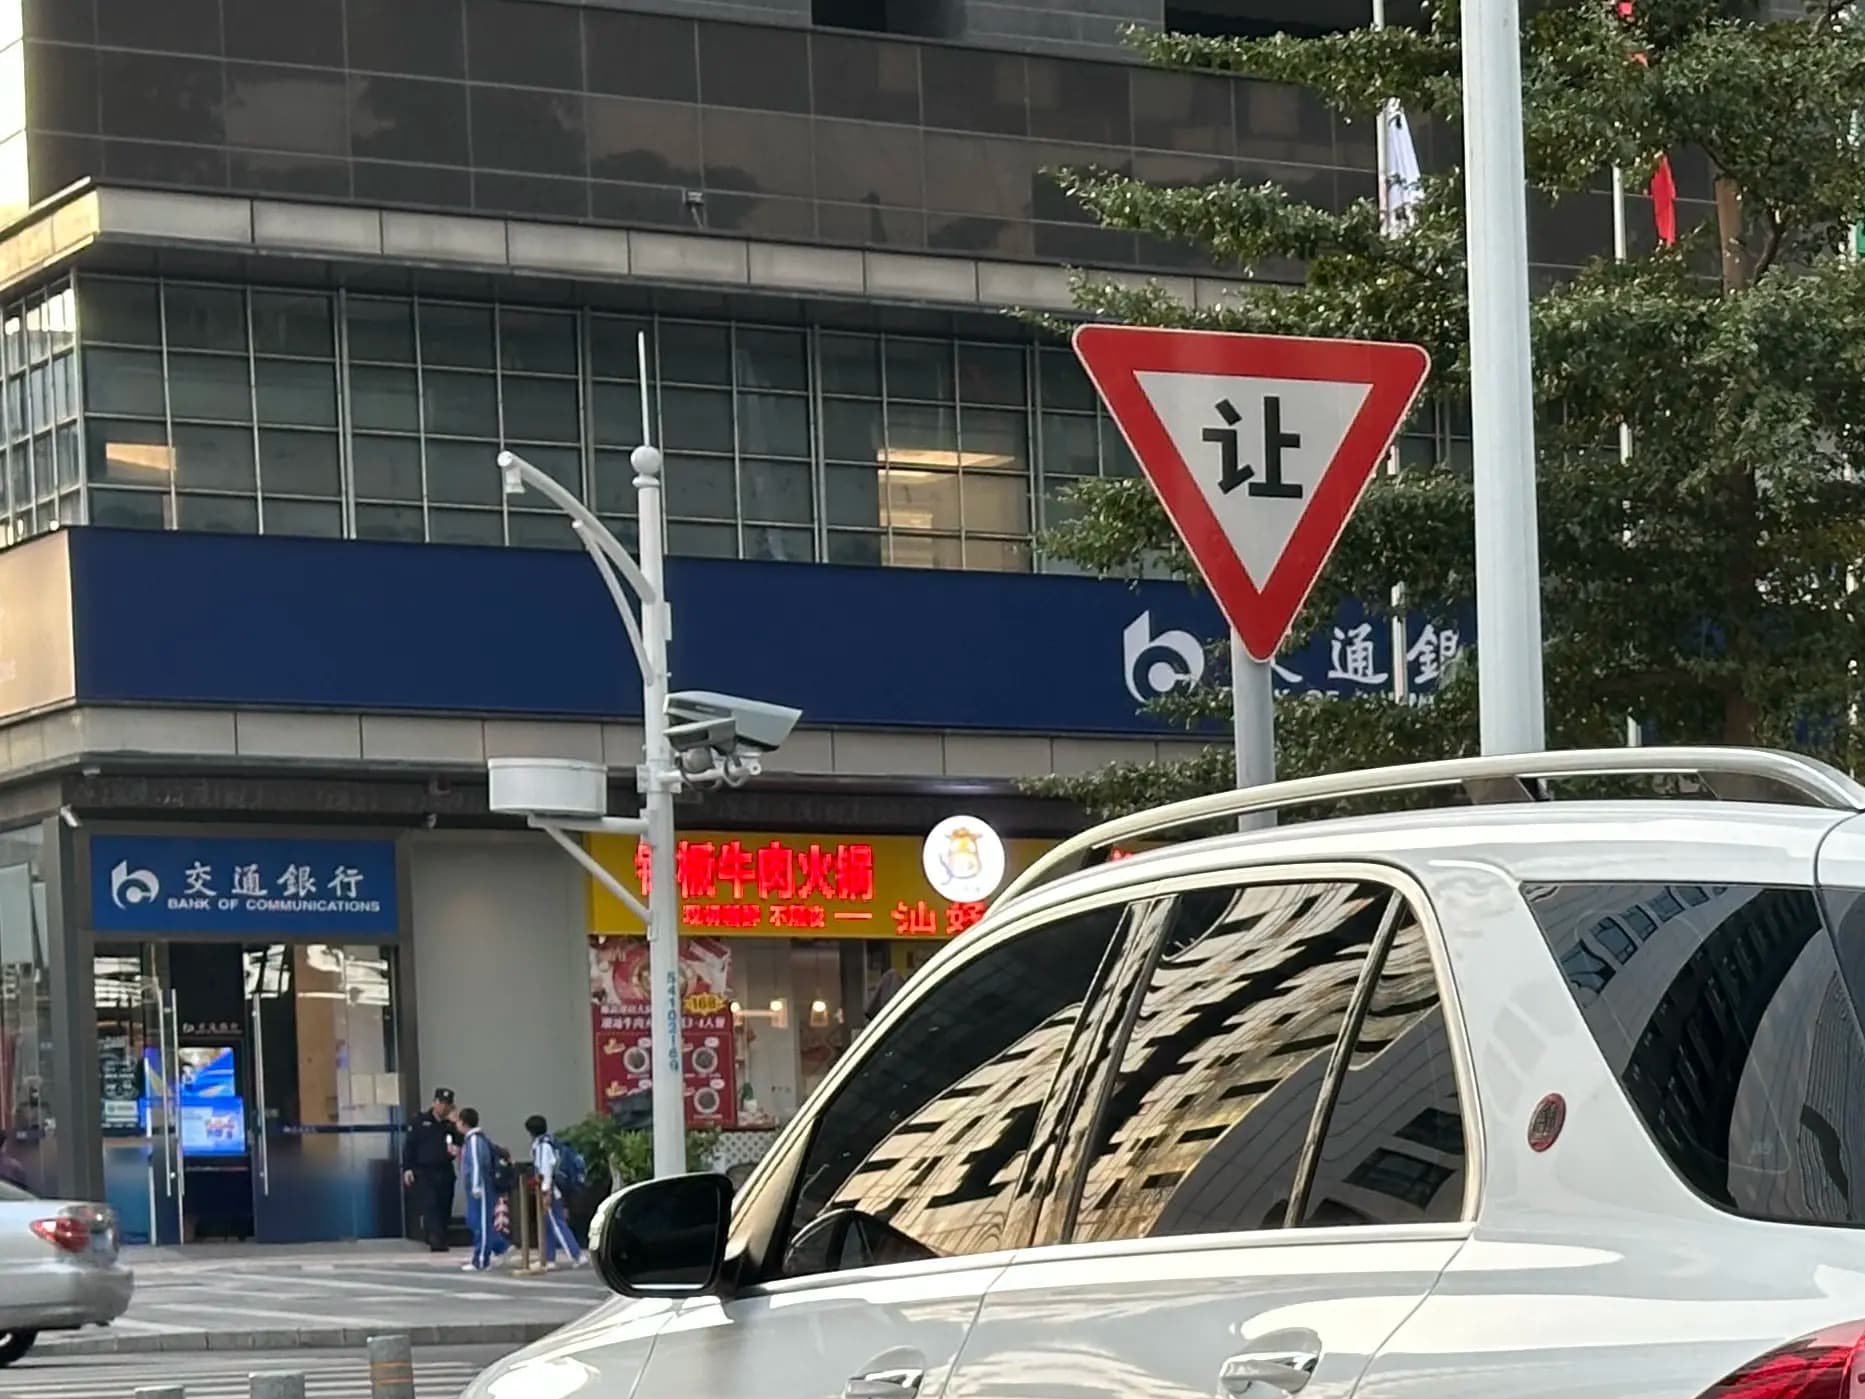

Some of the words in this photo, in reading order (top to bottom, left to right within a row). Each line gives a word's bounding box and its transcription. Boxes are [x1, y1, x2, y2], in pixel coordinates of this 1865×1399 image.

[1202, 396, 1303, 499] 让
[184, 861, 364, 898] 交通銀行
[168, 898, 210, 911] BANK
[218, 899, 238, 911] OF
[246, 899, 381, 912] COMMUNICATIONS
